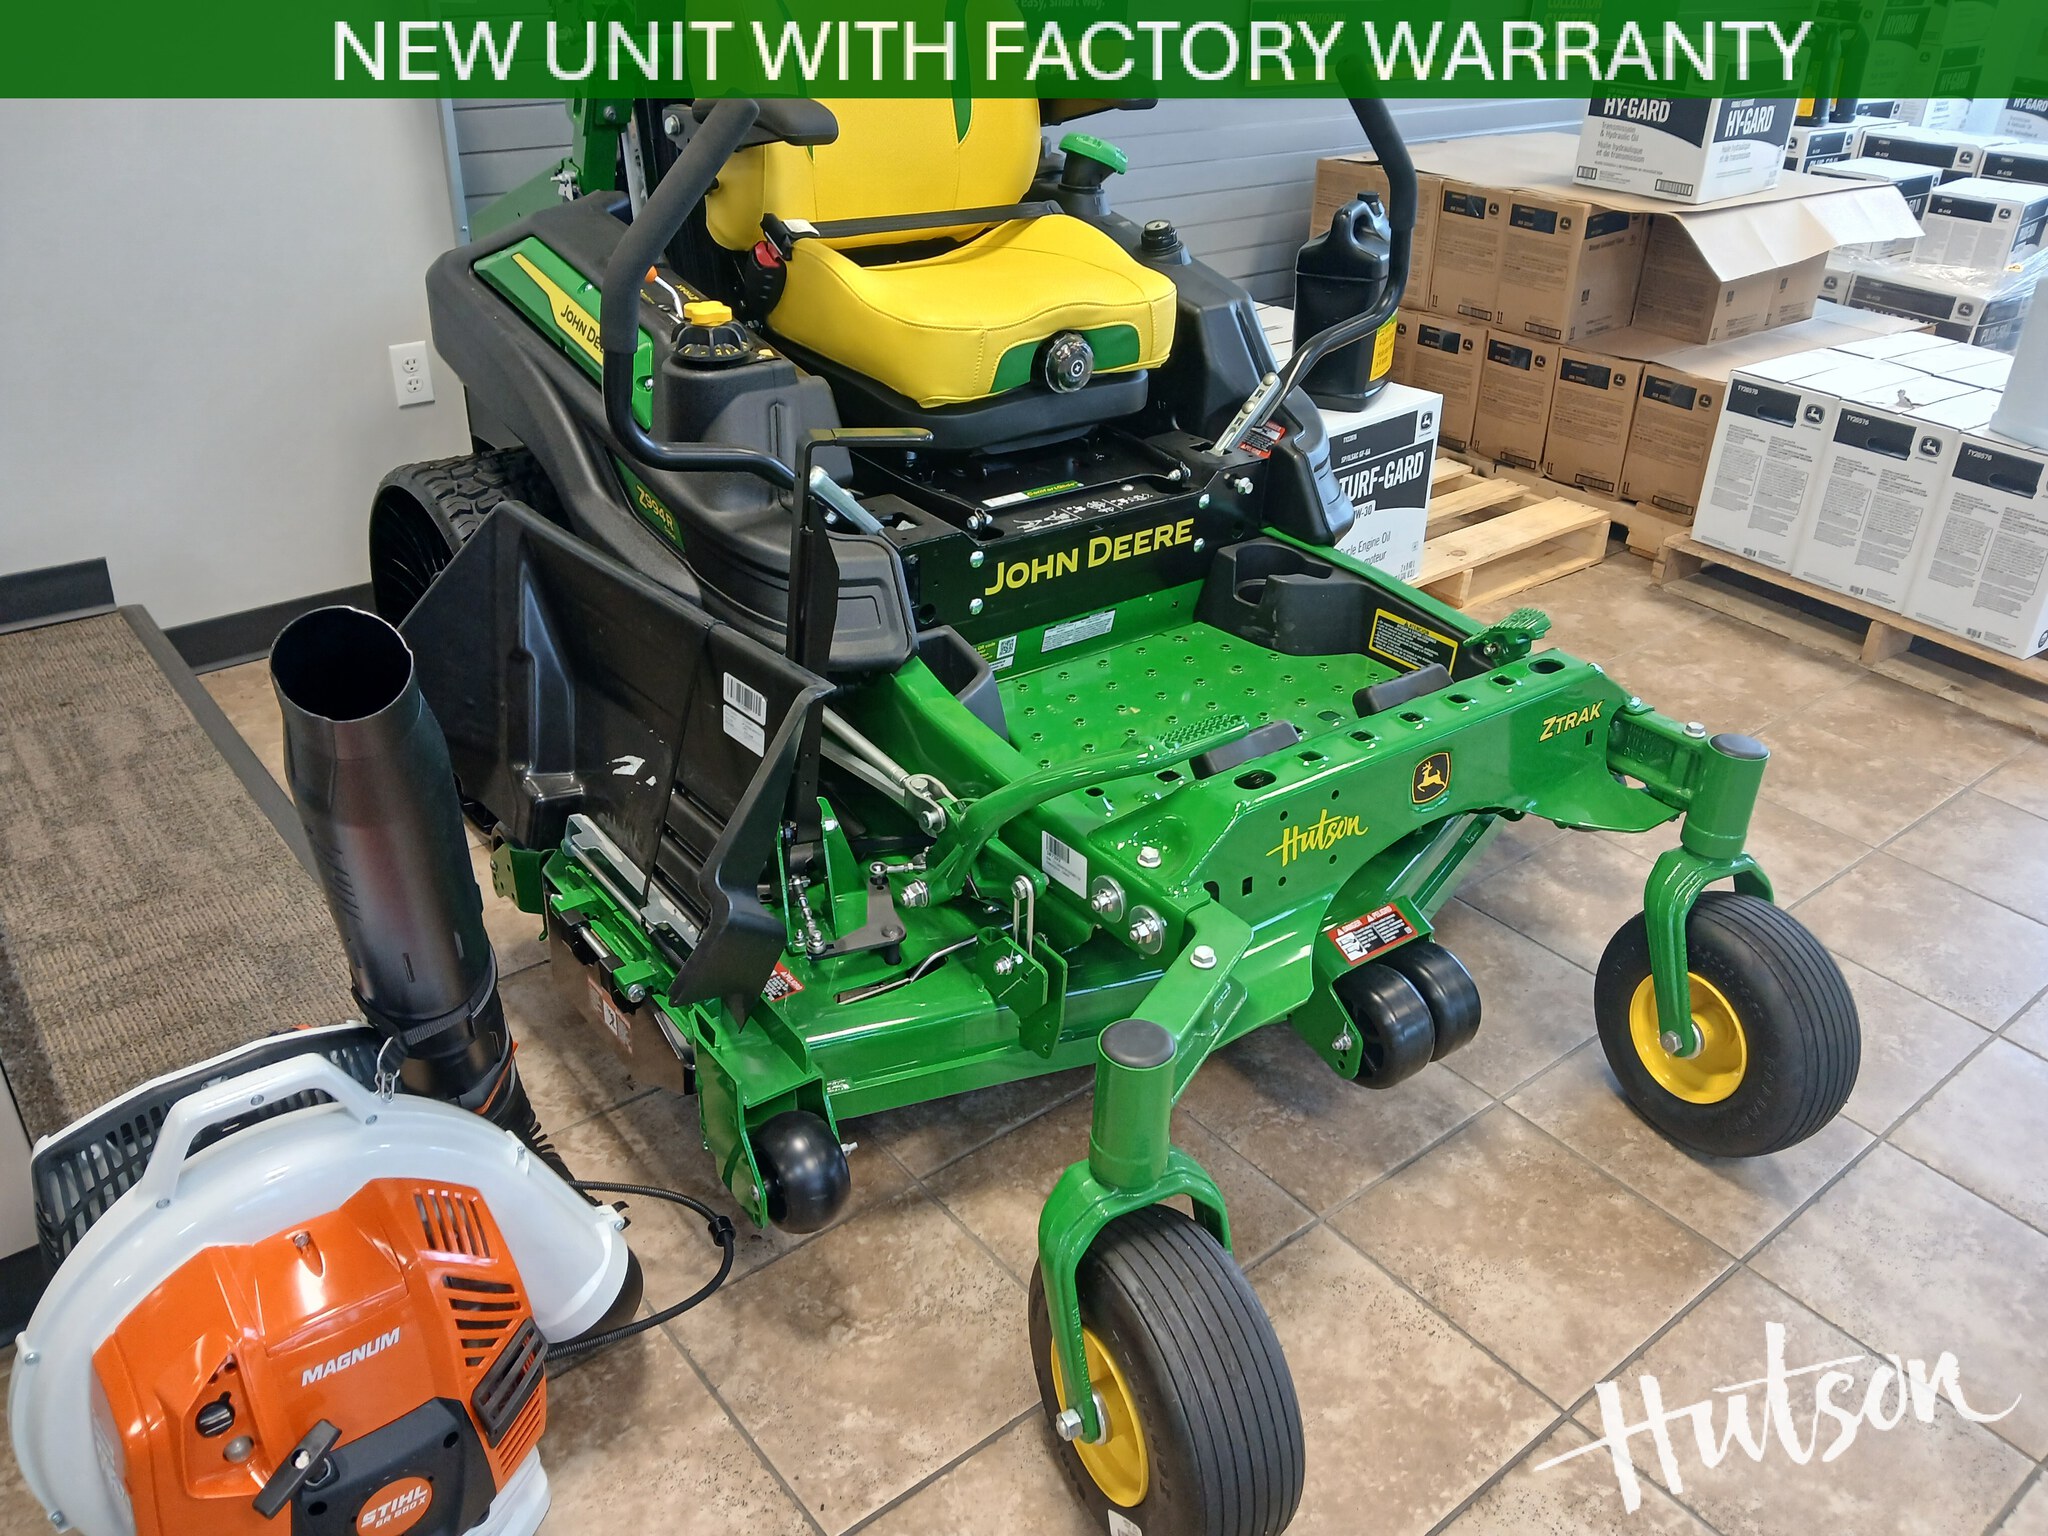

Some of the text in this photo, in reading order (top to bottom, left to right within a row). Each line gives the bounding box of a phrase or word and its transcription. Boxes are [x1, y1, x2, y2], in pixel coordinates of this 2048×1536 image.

[1603, 95, 1671, 123] HY-GARD
[1724, 105, 1775, 138] HY-GARD
[560, 304, 587, 337] JOHN
[1339, 452, 1424, 501] TURF-GARD
[636, 485, 674, 531] Z994R
[984, 518, 1195, 596] JOHN DEERE
[1357, 537, 1381, 554] Engine
[1381, 531, 1391, 544] Oil
[1538, 700, 1605, 743] ZTRAK
[1265, 808, 1369, 867] Hutson
[301, 1326, 401, 1388] MAGNUM
[361, 1485, 428, 1529] STIHL
